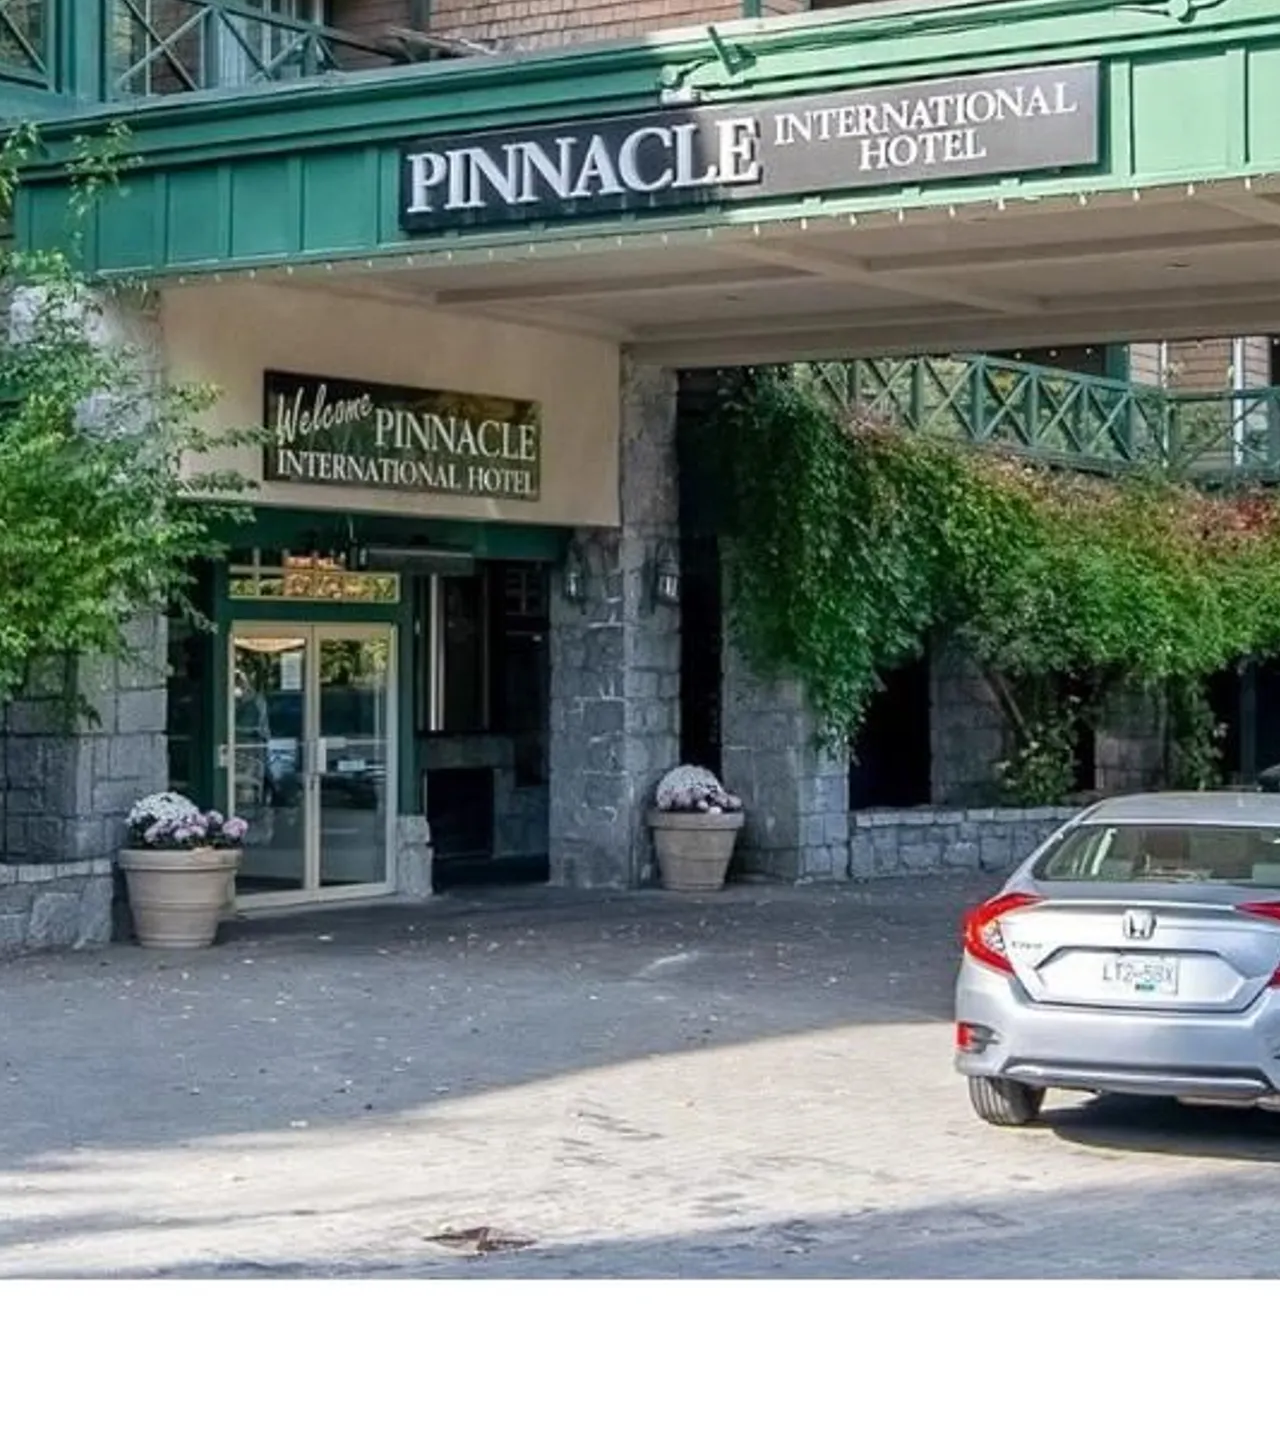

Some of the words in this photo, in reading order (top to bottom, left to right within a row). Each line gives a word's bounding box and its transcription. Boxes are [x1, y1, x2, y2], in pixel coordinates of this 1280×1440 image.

[774, 82, 1077, 146] INTERNATIONAL
[406, 116, 763, 214] PINNACLE
[858, 128, 986, 171] HOTEL
[277, 384, 373, 446] Welcome
[375, 408, 537, 461] PINNACLE
[277, 449, 462, 489] INTERNATIONAL
[468, 466, 535, 494] HOTEL
